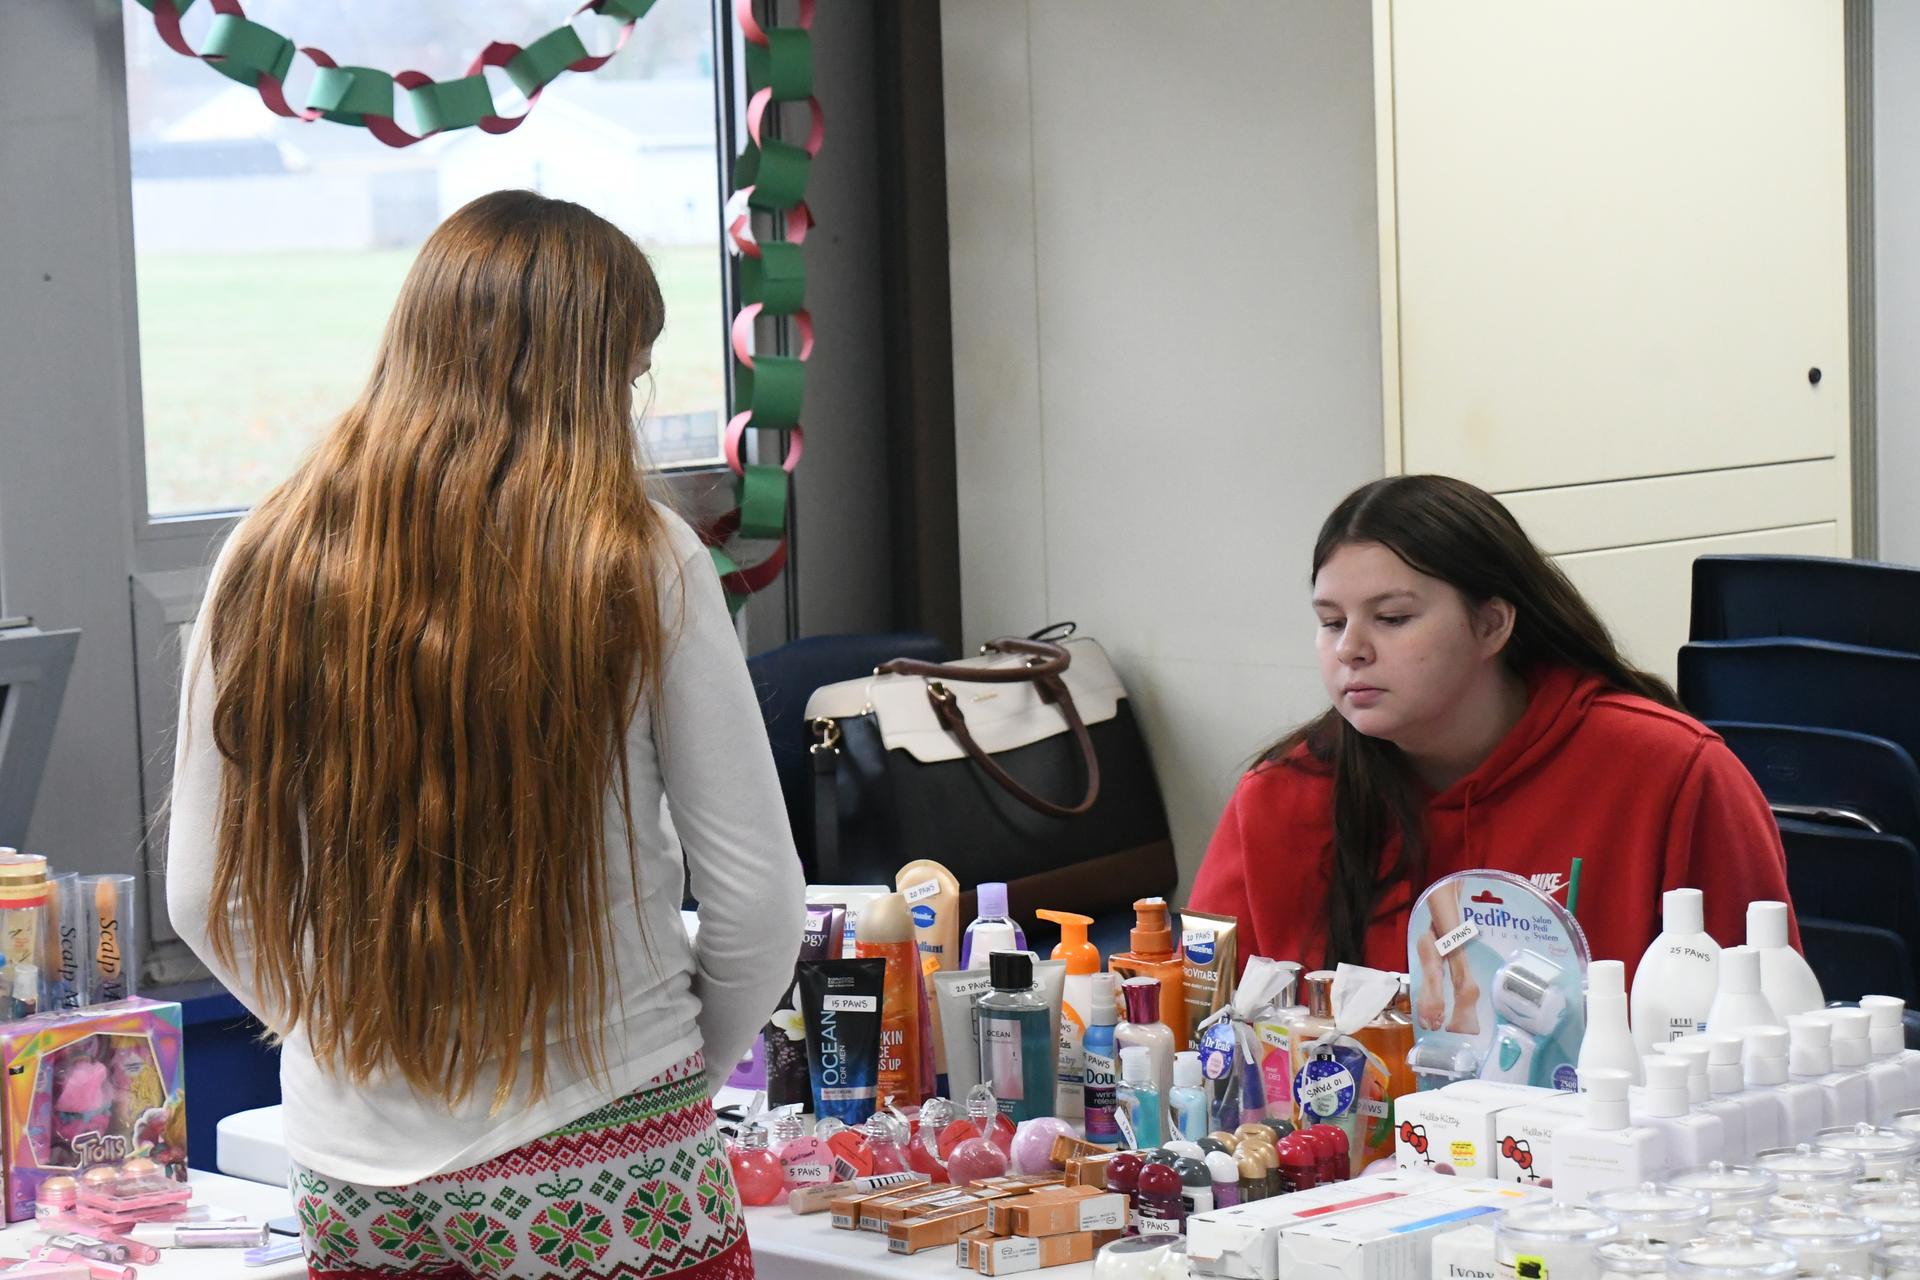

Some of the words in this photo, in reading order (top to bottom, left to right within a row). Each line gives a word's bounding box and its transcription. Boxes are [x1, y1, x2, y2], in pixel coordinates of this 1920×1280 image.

[1463, 907, 1530, 931] PediPro
[1533, 924, 1548, 932] Pedi
[802, 934, 825, 947] ogy
[1442, 940, 1451, 949] 20
[1451, 926, 1472, 942] PAWS
[1533, 932, 1559, 942] System
[97, 917, 120, 973] Scalp
[58, 925, 78, 982] Scalp
[1670, 946, 1681, 954] 25
[1684, 947, 1711, 962] PAWS
[955, 985, 966, 993] 20
[968, 980, 992, 990] PAWS
[831, 1000, 839, 1008] 15
[843, 1000, 868, 1009] PAWS
[986, 1030, 1011, 1038] OCEAN
[820, 1010, 839, 1086] OCEAN
[1205, 1036, 1214, 1047] Dr
[888, 1059, 901, 1071] UP
[1088, 1055, 1111, 1069] PAWS
[840, 1068, 848, 1085] FOR
[1306, 1083, 1332, 1098] PAWS
[1420, 1110, 1439, 1122] Hello
[1439, 1114, 1460, 1128] Kitty
[1523, 1125, 1542, 1137] Hello
[789, 1168, 795, 1176] 5
[797, 1168, 821, 1176] PAWS
[1140, 1220, 1145, 1229] 5
[1147, 1220, 1170, 1232] PAWS
